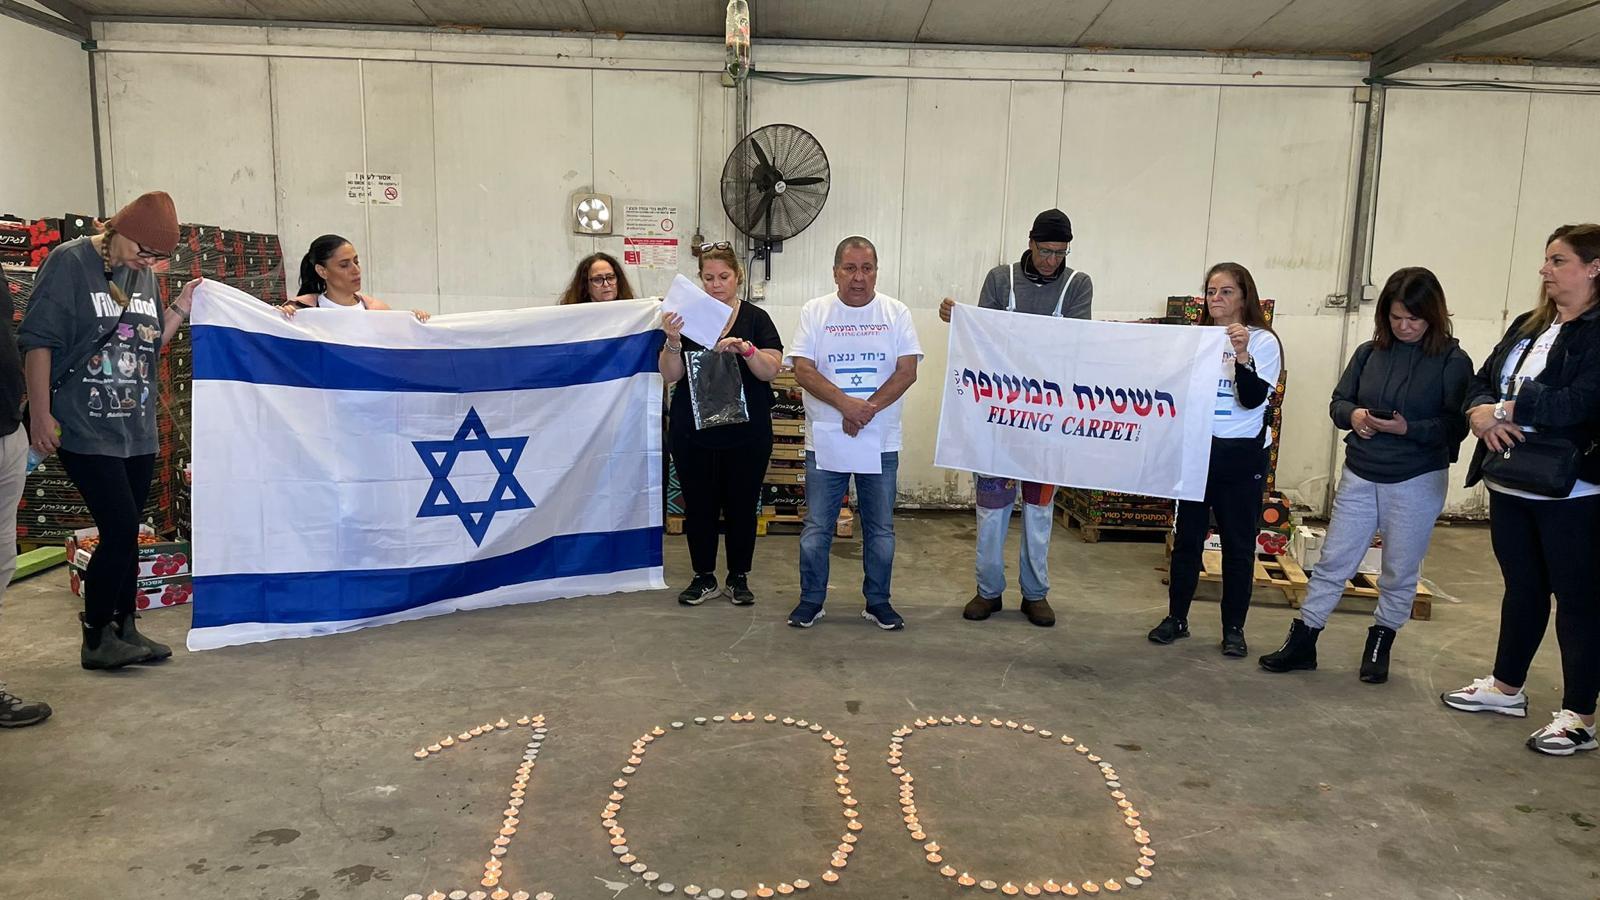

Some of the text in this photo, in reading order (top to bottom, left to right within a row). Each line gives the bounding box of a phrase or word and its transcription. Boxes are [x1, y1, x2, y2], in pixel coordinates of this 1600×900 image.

[859, 324, 889, 332] השטיח
[828, 352, 886, 363] ביחד ננצח
[962, 367, 1064, 408] המעופף
[1072, 383, 1177, 418] השטיח
[986, 405, 1054, 433] FLYING
[1061, 415, 1138, 442] CARPET
[1122, 511, 1134, 519] של
[1135, 512, 1168, 522] המתוקים
